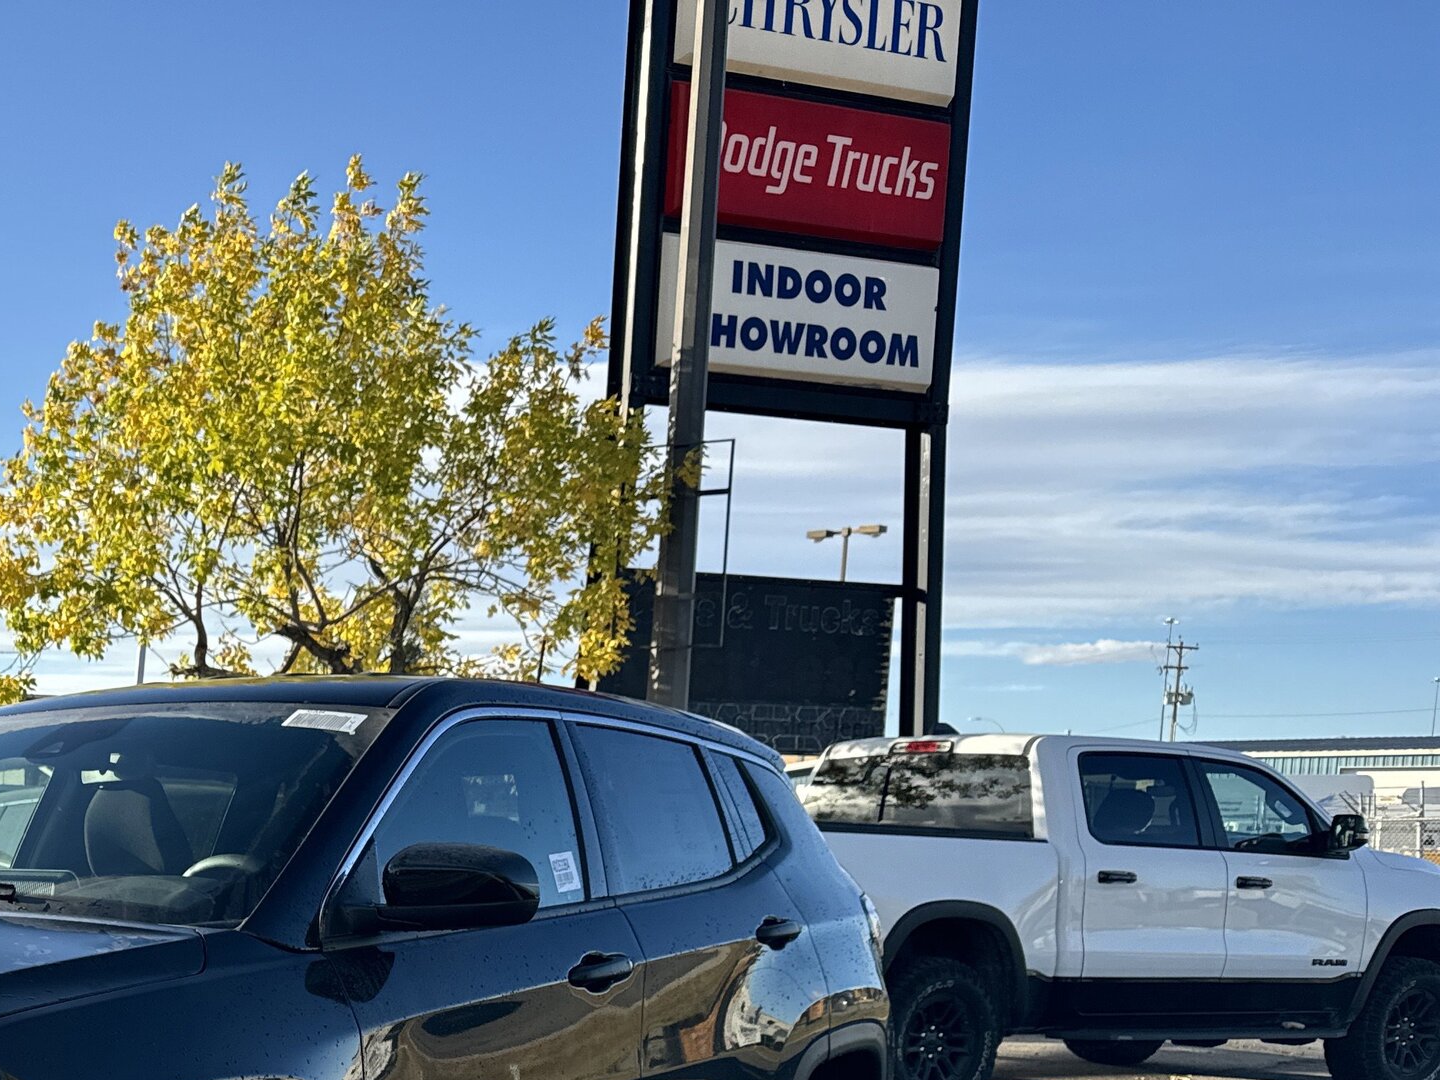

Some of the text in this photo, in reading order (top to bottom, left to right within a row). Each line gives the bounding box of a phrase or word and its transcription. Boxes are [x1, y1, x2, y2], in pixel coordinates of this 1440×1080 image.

[728, 0, 948, 63] HRYSLER
[719, 120, 939, 201] odge Trucks
[731, 260, 887, 312] INDOOR
[710, 313, 920, 369] HOWROOM
[763, 593, 881, 637] Trucks
[1311, 958, 1348, 967] RAM
